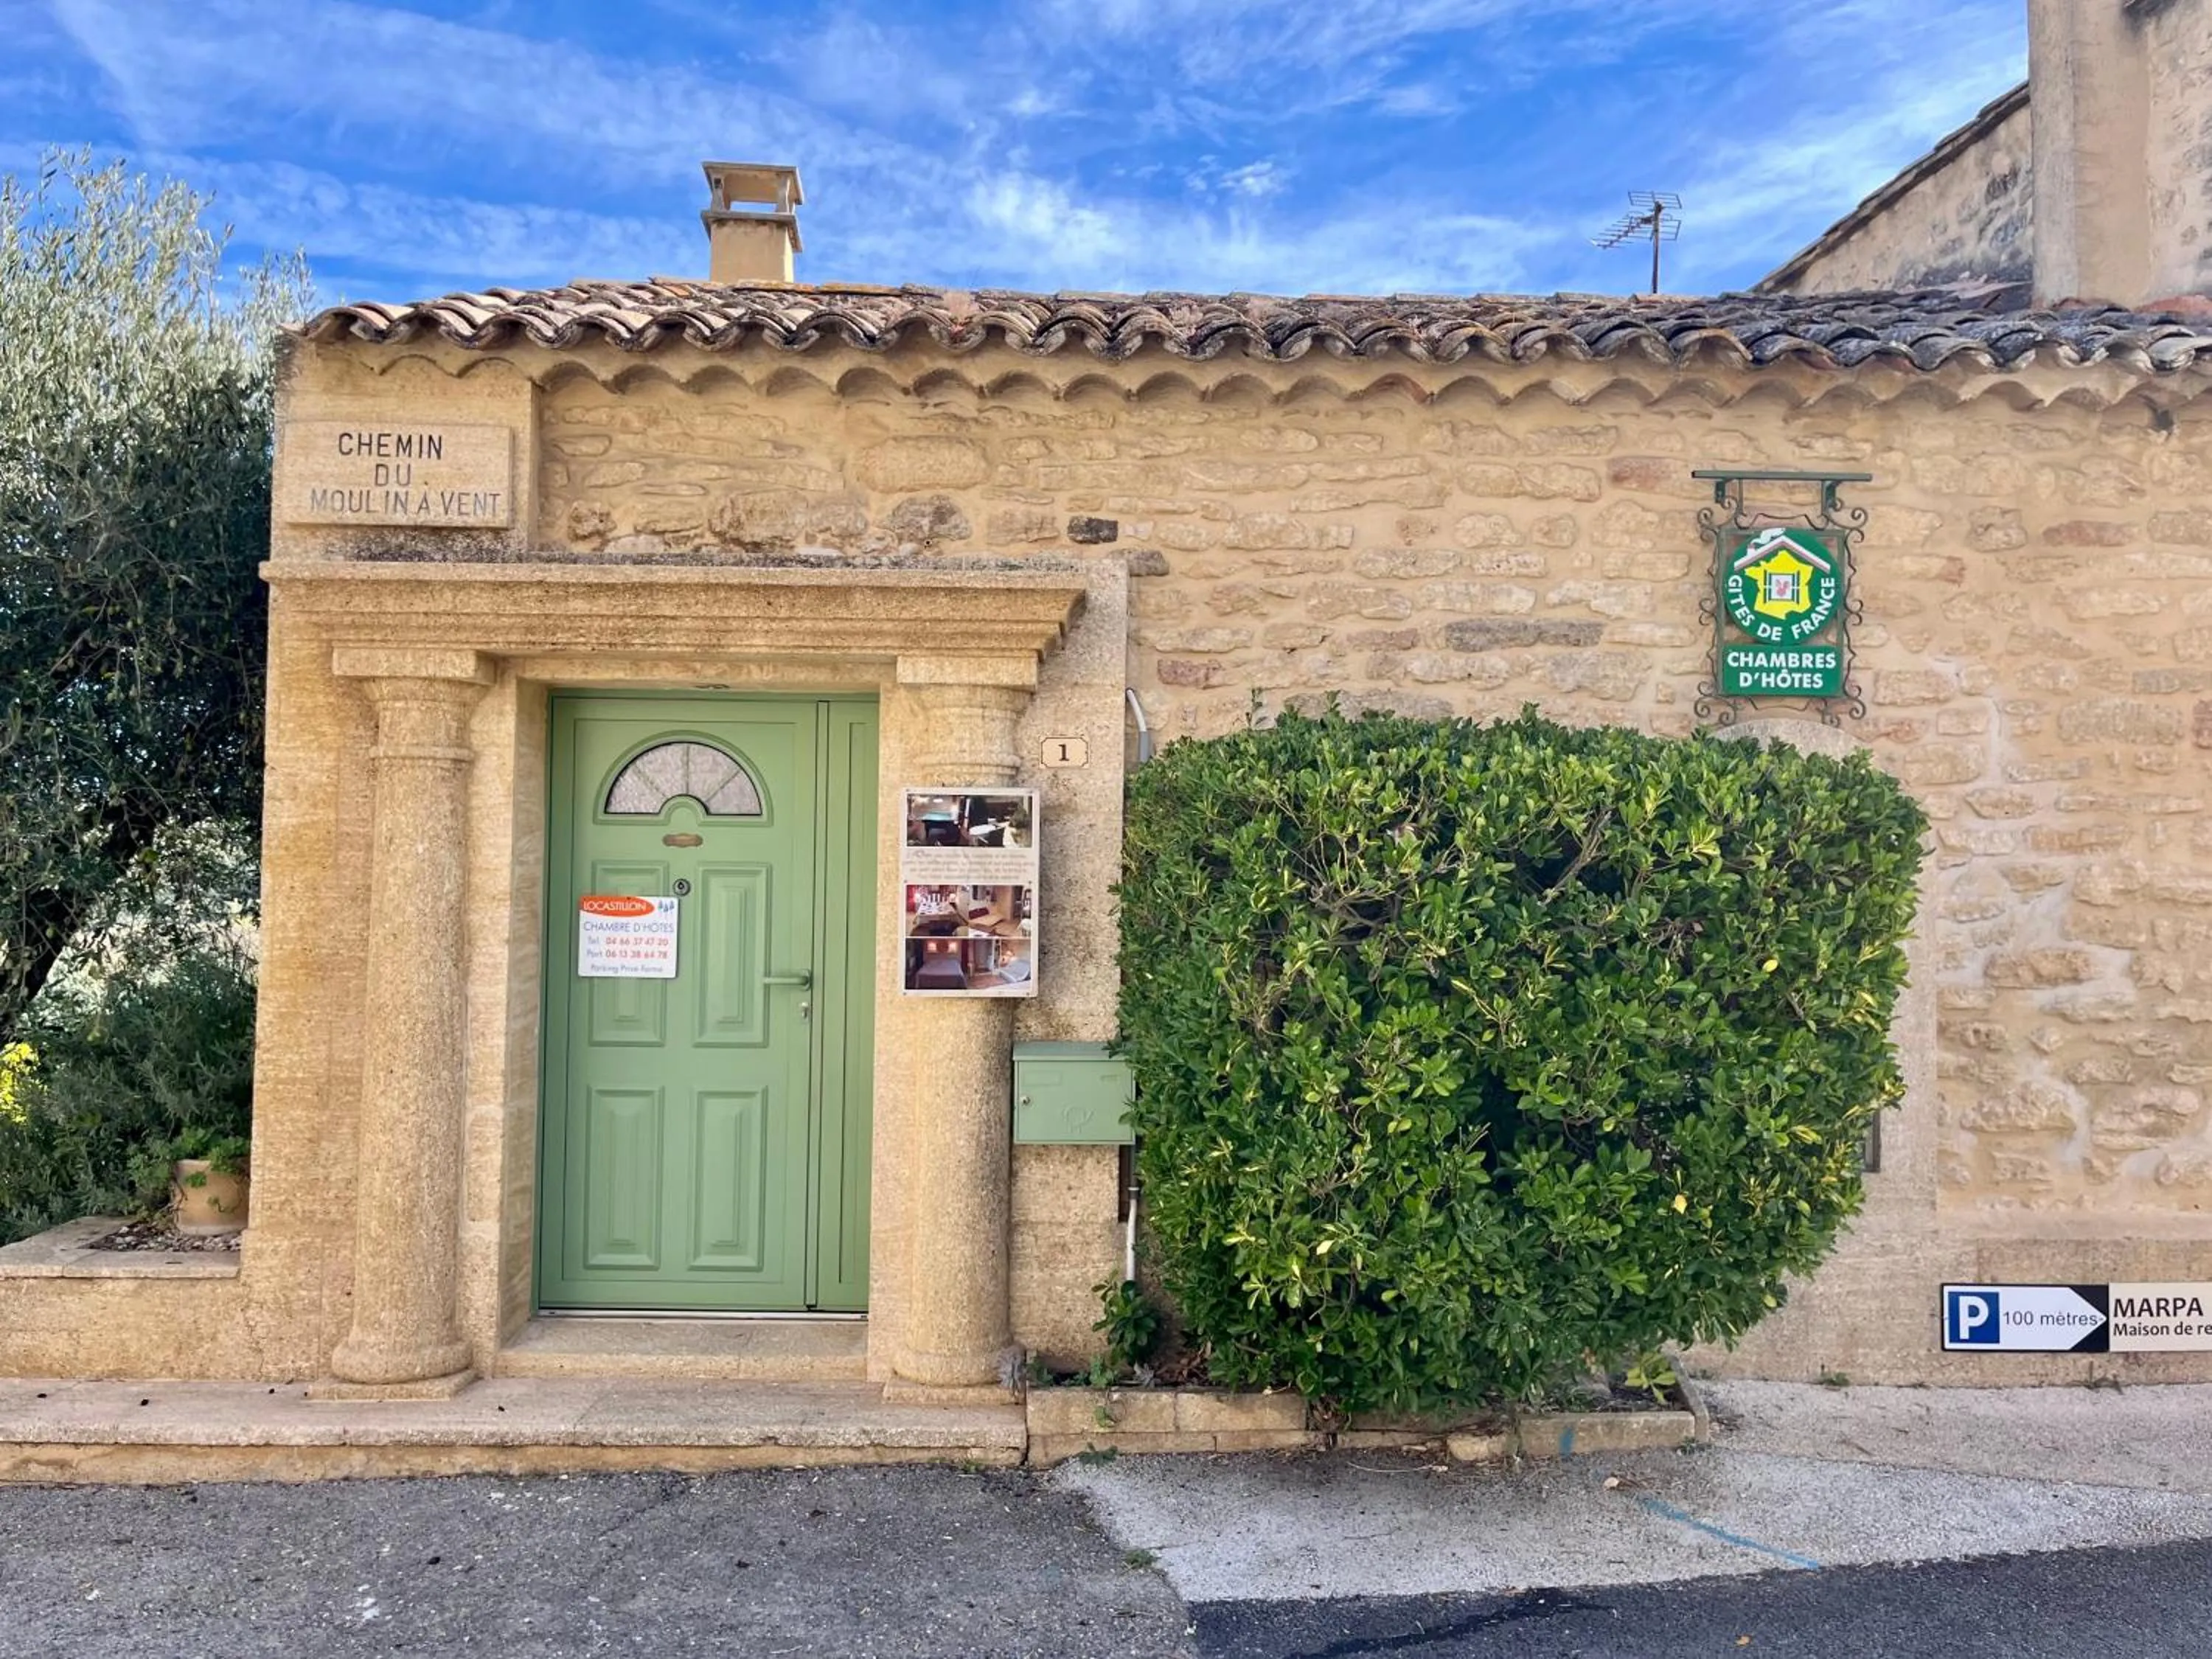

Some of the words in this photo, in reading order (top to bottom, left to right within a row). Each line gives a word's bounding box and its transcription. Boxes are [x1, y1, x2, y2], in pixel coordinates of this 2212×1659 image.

[338, 432, 442, 460] CHEMIN
[375, 463, 411, 487] DU
[310, 488, 408, 515] MOULIN
[440, 490, 501, 516] VENT
[1756, 623, 1782, 641] DE
[1790, 577, 1835, 639] FRANCE
[1727, 652, 1836, 669] CHAMBRES
[1739, 669, 1823, 689] D'HÔTES
[1057, 743, 1070, 762] 1
[583, 922, 630, 932] CHAMBRE
[1958, 1295, 1989, 1340] P
[2003, 1311, 2034, 1325] 100
[2040, 1310, 2098, 1326] mètres
[2113, 1297, 2204, 1318] MARPA
[2113, 1322, 2169, 1336] Maison
[2174, 1321, 2193, 1335] de
